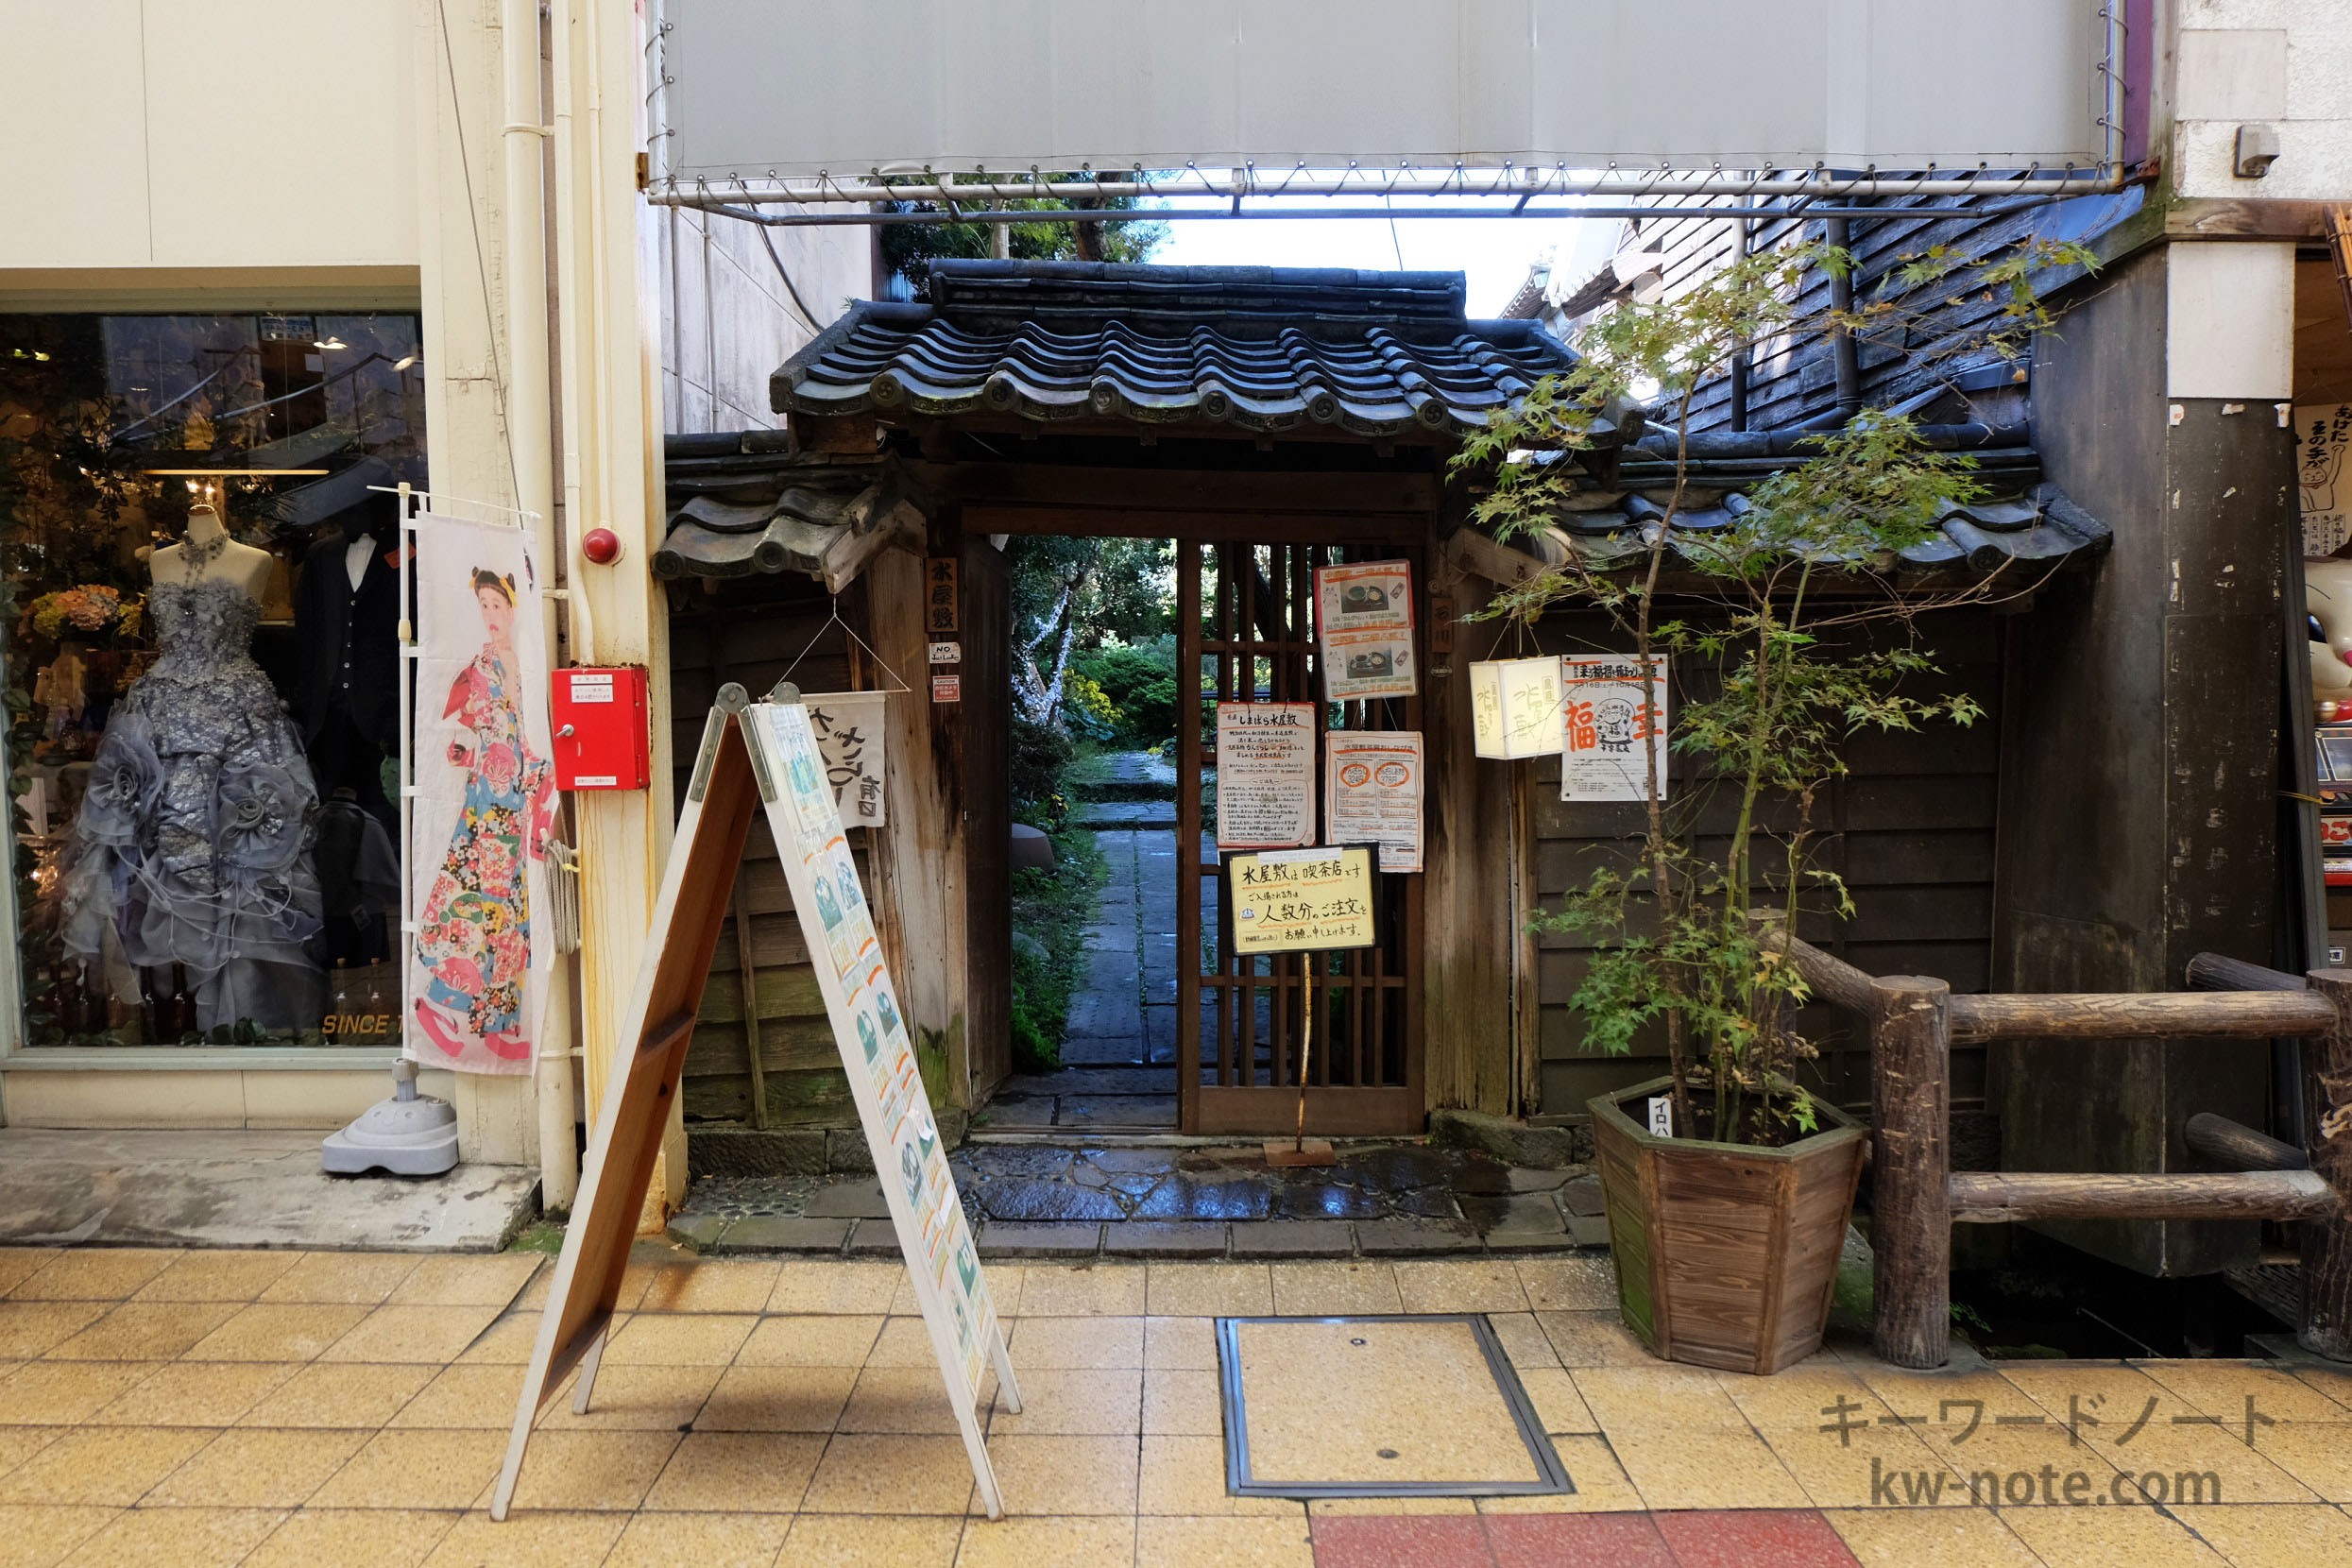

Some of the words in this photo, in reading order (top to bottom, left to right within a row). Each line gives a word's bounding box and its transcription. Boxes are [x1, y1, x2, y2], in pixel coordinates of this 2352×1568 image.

[1239, 713, 1299, 726] しまばら水屋敷
[1564, 700, 1596, 752] 福
[1248, 890, 1299, 901] ご入場される方は
[1258, 897, 1367, 925] 人数分のご注文を
[322, 1014, 389, 1033] SINCE
[1655, 1101, 1669, 1136] イロハ
